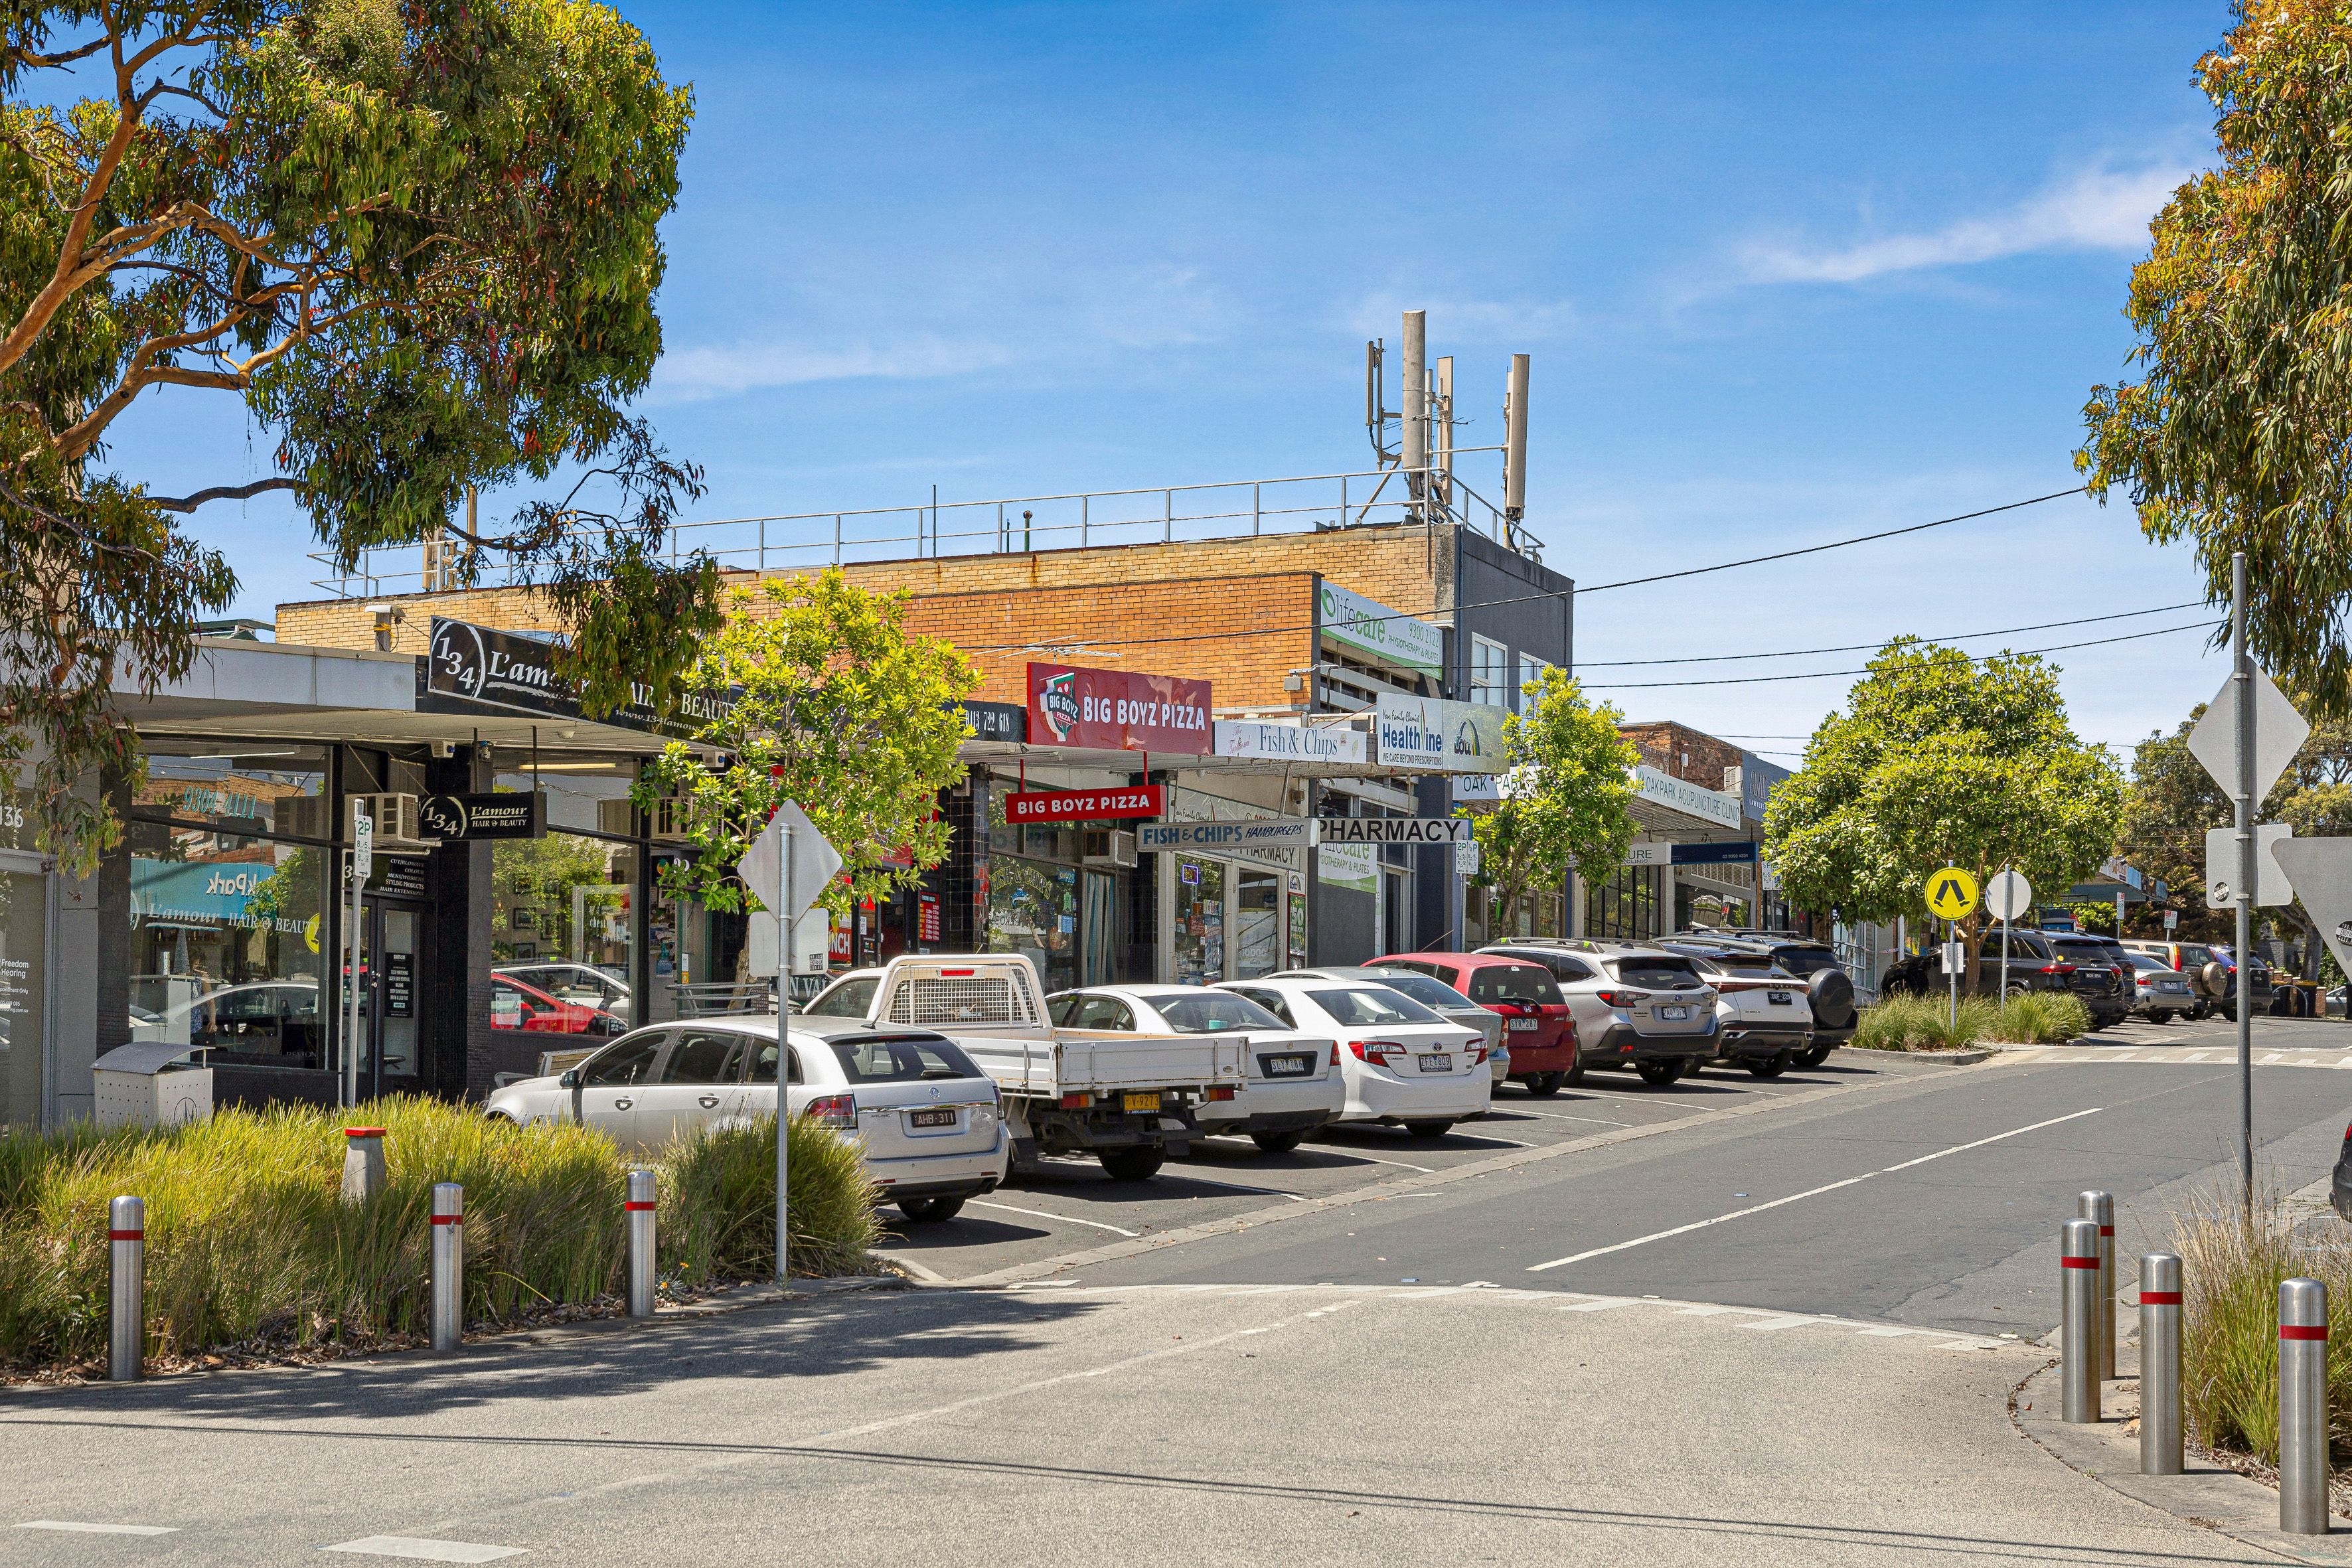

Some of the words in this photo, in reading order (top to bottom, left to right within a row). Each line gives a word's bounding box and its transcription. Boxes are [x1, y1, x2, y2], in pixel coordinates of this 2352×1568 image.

[1336, 595, 1385, 643] lifecare
[1409, 622, 1424, 641] 9300
[1425, 630, 1439, 649] 2122
[1387, 635, 1420, 655] PHYSIOTHERAPY
[1425, 649, 1439, 663] PILATES
[436, 637, 474, 689] 134
[1050, 694, 1060, 708] BIG
[1061, 697, 1079, 719] BOYZ
[1083, 696, 1111, 723] BIG
[1117, 699, 1156, 726] BOYZ
[1162, 703, 1205, 730] PIZZA
[984, 712, 995, 731] 722
[999, 712, 1010, 732] 618
[1056, 712, 1071, 722] PIZZA
[1391, 710, 1405, 725] Family
[1405, 711, 1420, 722] Chemist
[1259, 725, 1286, 753] Fish
[1289, 728, 1299, 754] &
[1304, 729, 1338, 761] Chips
[1389, 753, 1399, 762] CARE
[1400, 755, 1415, 764] BEYOND
[1415, 756, 1442, 766] PRESCRIPTIONS
[1463, 775, 1488, 792] OAK
[1494, 775, 1520, 791] PAR
[471, 800, 528, 817] L'amour
[1018, 801, 1046, 815] BIG
[1052, 798, 1095, 813] BOYZ
[1101, 795, 1150, 809] PIZZA
[1678, 787, 1721, 816] ACUPUNCTURE
[1722, 803, 1740, 823] CLINIC
[358, 821, 370, 836] 2P
[424, 807, 458, 834] 134
[1143, 828, 1180, 844] FISH
[1182, 828, 1192, 840] &
[1194, 826, 1243, 843] CHIPS
[1245, 824, 1304, 838] HAMBURGERS
[1320, 821, 1461, 842] PHARMACY
[1354, 864, 1370, 874] PILATES
[403, 881, 424, 890] PRODUCTS
[148, 903, 220, 924] L'amour
[228, 912, 258, 928] HAIR
[274, 917, 320, 937] BEAUTY
[1, 959, 29, 969] Freedom
[1, 969, 26, 979] Hearing
[1272, 1059, 1285, 1070] SLY
[1421, 1056, 1433, 1067] ZFE
[1438, 1056, 1450, 1065] 809
